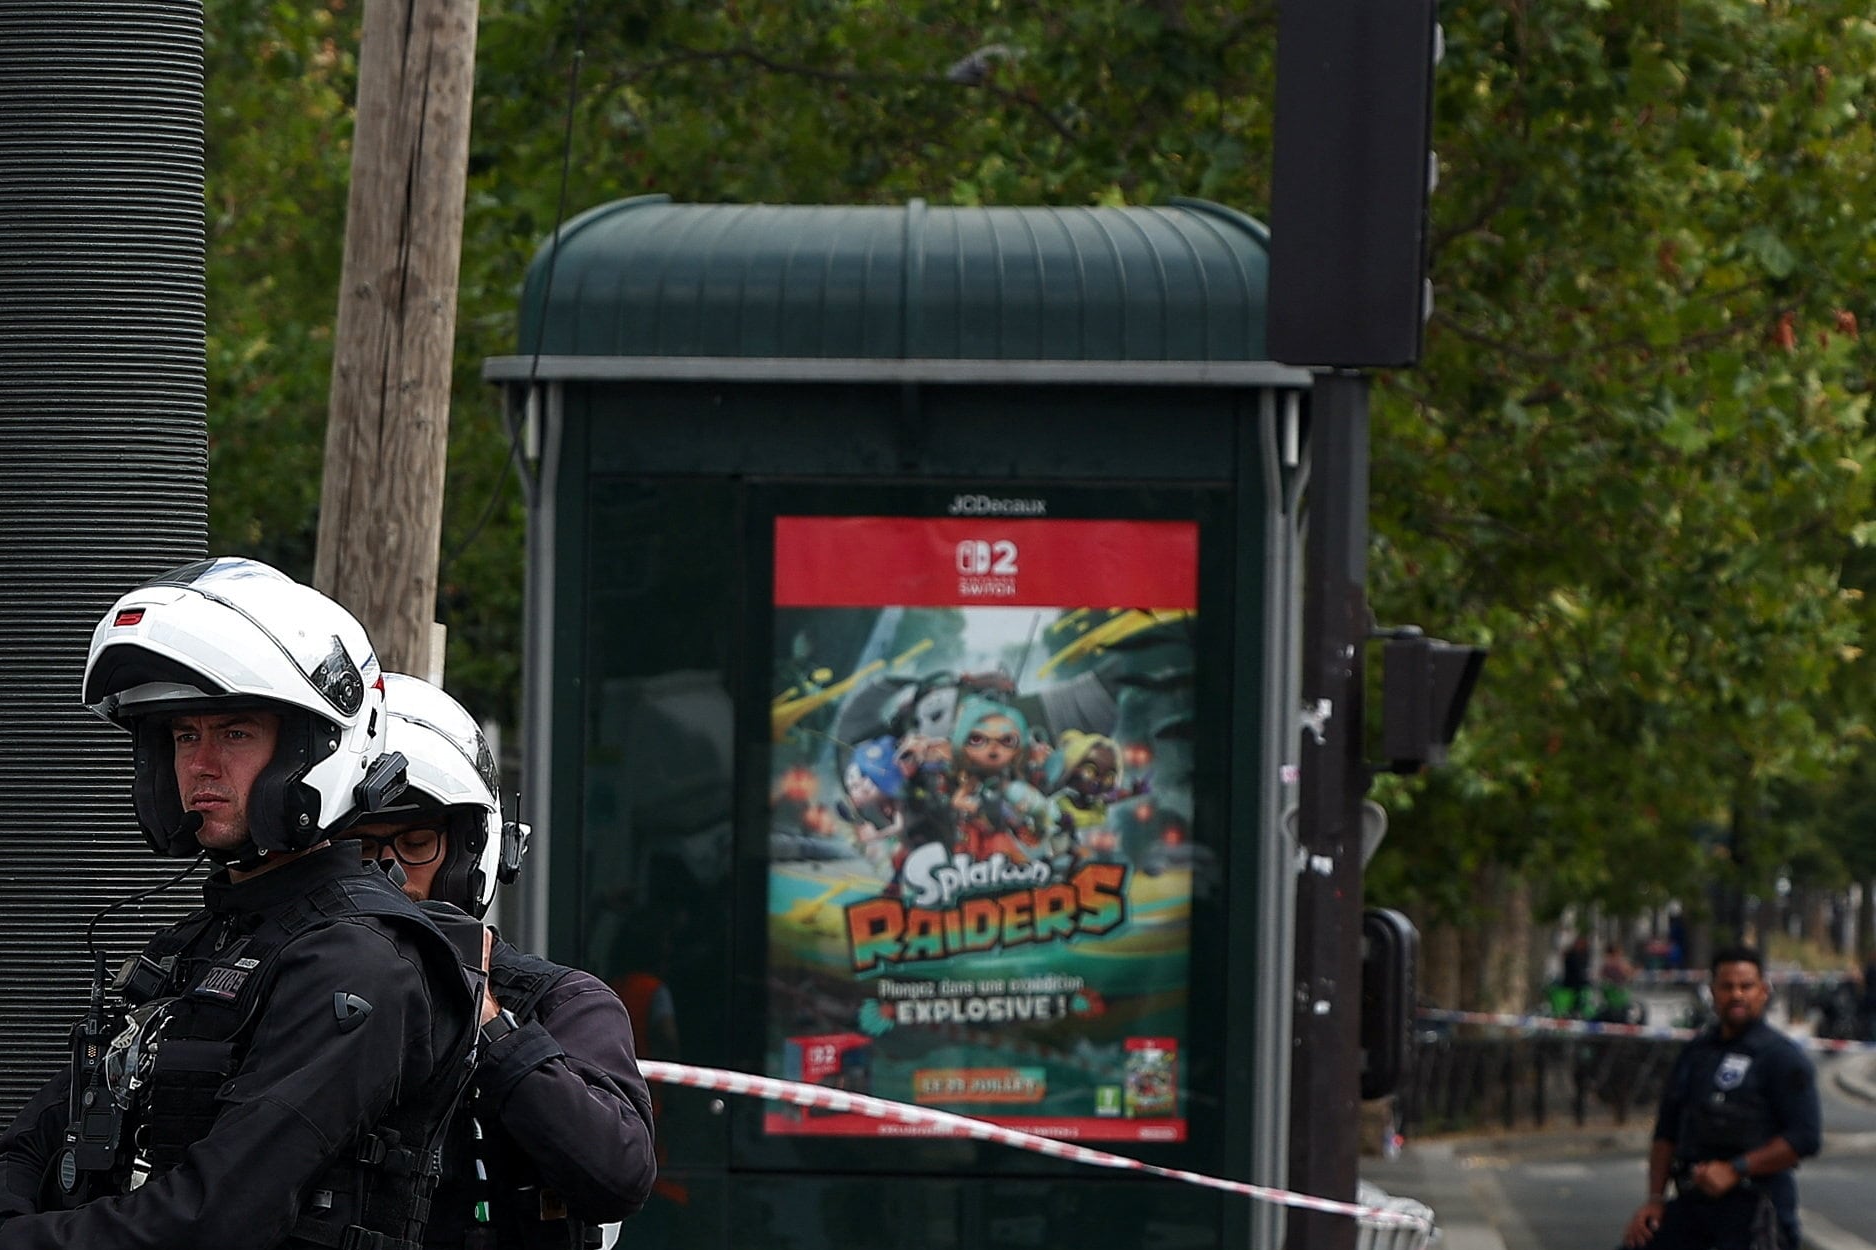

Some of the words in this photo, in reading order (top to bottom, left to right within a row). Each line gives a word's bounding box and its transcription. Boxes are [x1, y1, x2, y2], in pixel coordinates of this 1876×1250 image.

[949, 495, 1046, 514] JCDecaux
[992, 540, 1018, 574] 2
[905, 843, 1051, 904] Splatoon
[848, 864, 1125, 971] RAIDERS
[896, 996, 1051, 1023] EXPLOSIVE
